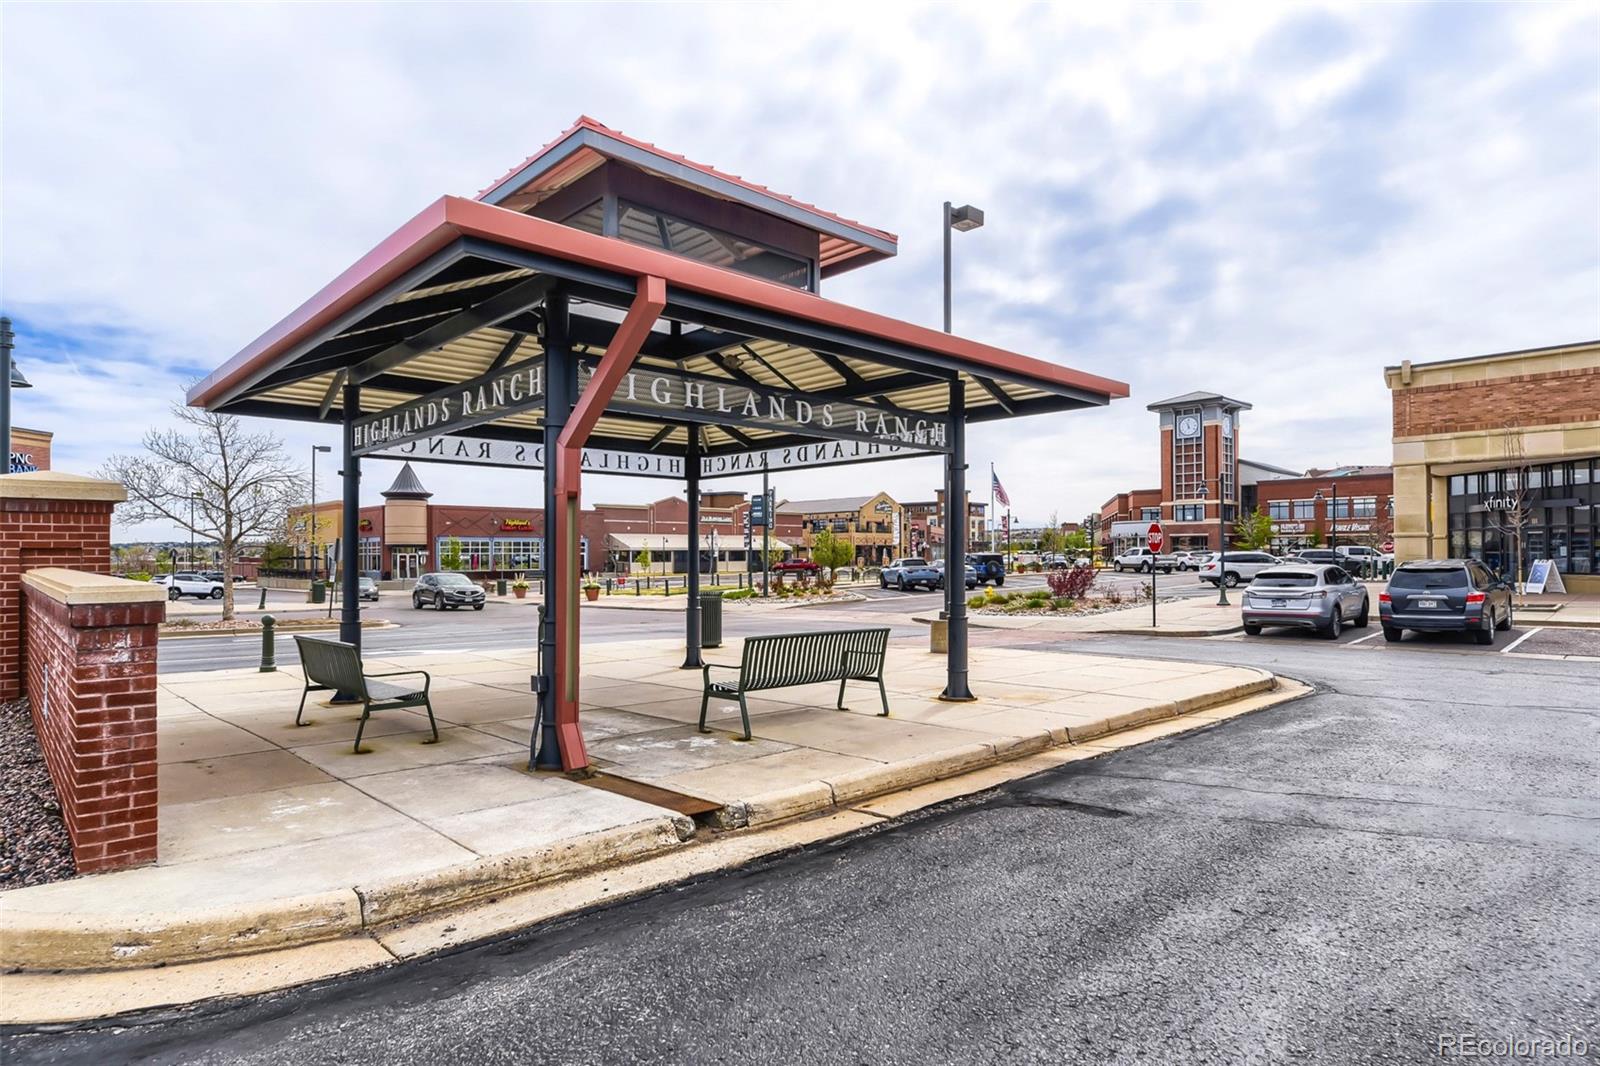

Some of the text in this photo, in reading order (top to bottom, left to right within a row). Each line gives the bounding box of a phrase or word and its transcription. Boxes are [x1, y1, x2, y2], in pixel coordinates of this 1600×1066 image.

[353, 366, 543, 447] HIGHLANDS RANCH
[588, 366, 947, 443] IGHLANDS RANCH
[10, 452, 34, 465] PNC
[1484, 496, 1518, 512] xfinity
[1148, 532, 1162, 543] STOP
